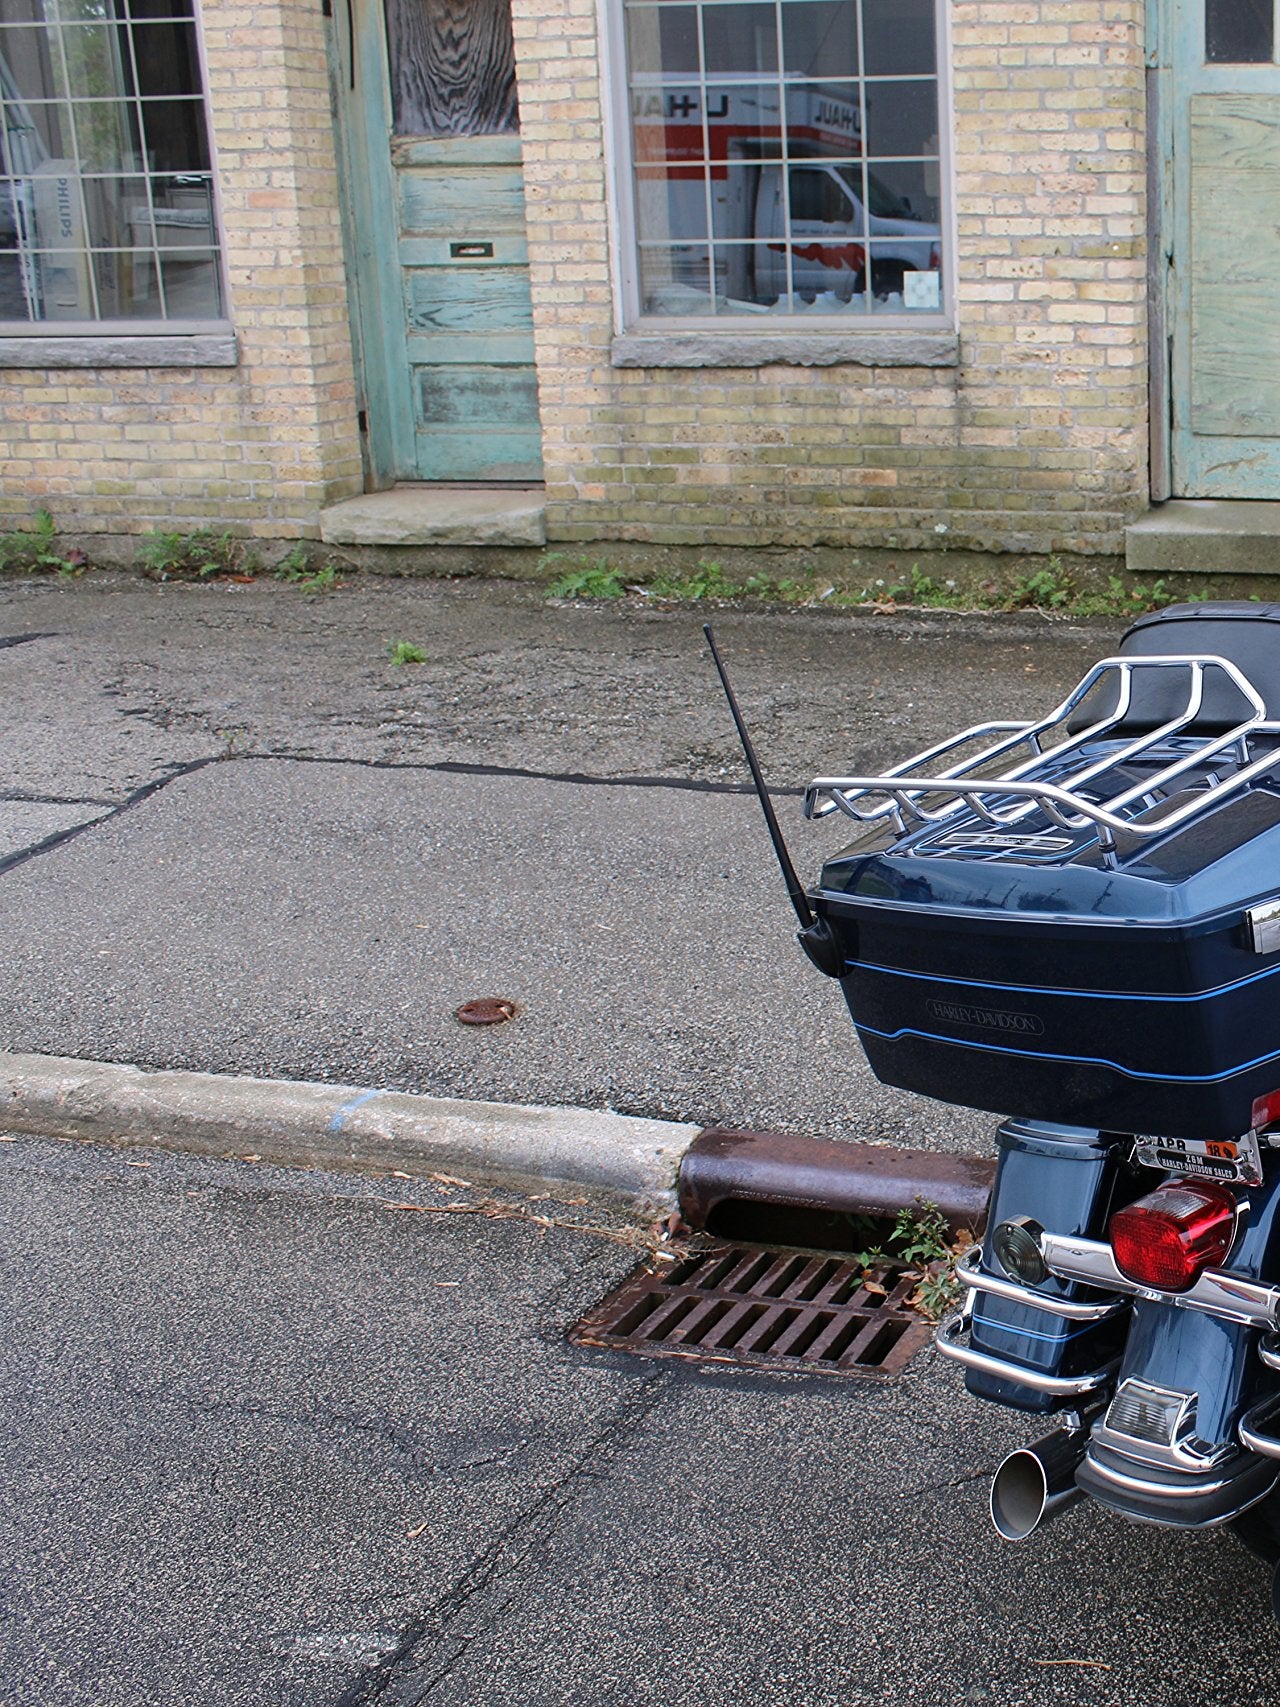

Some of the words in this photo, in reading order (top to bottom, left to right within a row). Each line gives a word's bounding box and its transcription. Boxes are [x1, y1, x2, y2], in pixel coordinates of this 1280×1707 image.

[57, 177, 72, 238] PHILIPS
[933, 1003, 1035, 1031] HARLEY-DAVIDSON
[1161, 1158, 1213, 1176] HARLEY-DAVIDSON
[1214, 1167, 1233, 1179] SALES
